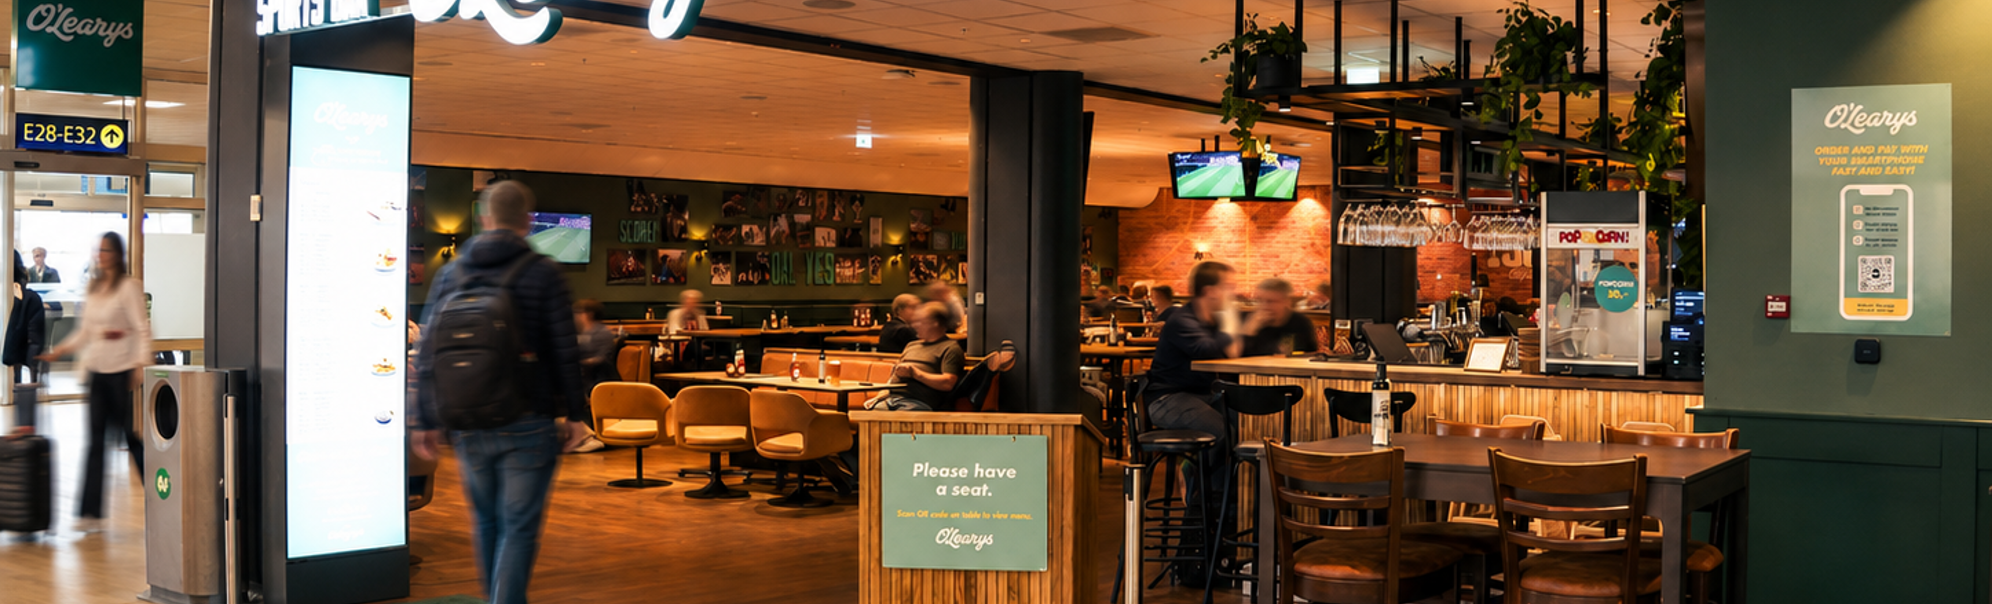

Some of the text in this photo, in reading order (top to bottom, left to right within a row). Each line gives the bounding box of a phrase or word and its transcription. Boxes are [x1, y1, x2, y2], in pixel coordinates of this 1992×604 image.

[26, 3, 134, 48] O'Learys
[1824, 102, 1918, 135] O'Learys
[23, 123, 96, 144] E28-E32
[1814, 144, 1929, 155] ORDER AND PAY WITH
[1818, 155, 1926, 166] YOUR SMARTPHONE
[1831, 166, 1857, 176] FAST
[1857, 166, 1882, 176] AND
[912, 461, 1017, 478] Please have
[936, 483, 993, 497] a seat.
[896, 509, 916, 518] Scan
[917, 510, 929, 518] QR
[930, 510, 949, 519] code
[962, 510, 981, 519] table
[982, 511, 991, 519] to
[992, 510, 1009, 519] view
[935, 527, 994, 551] O'Learys
